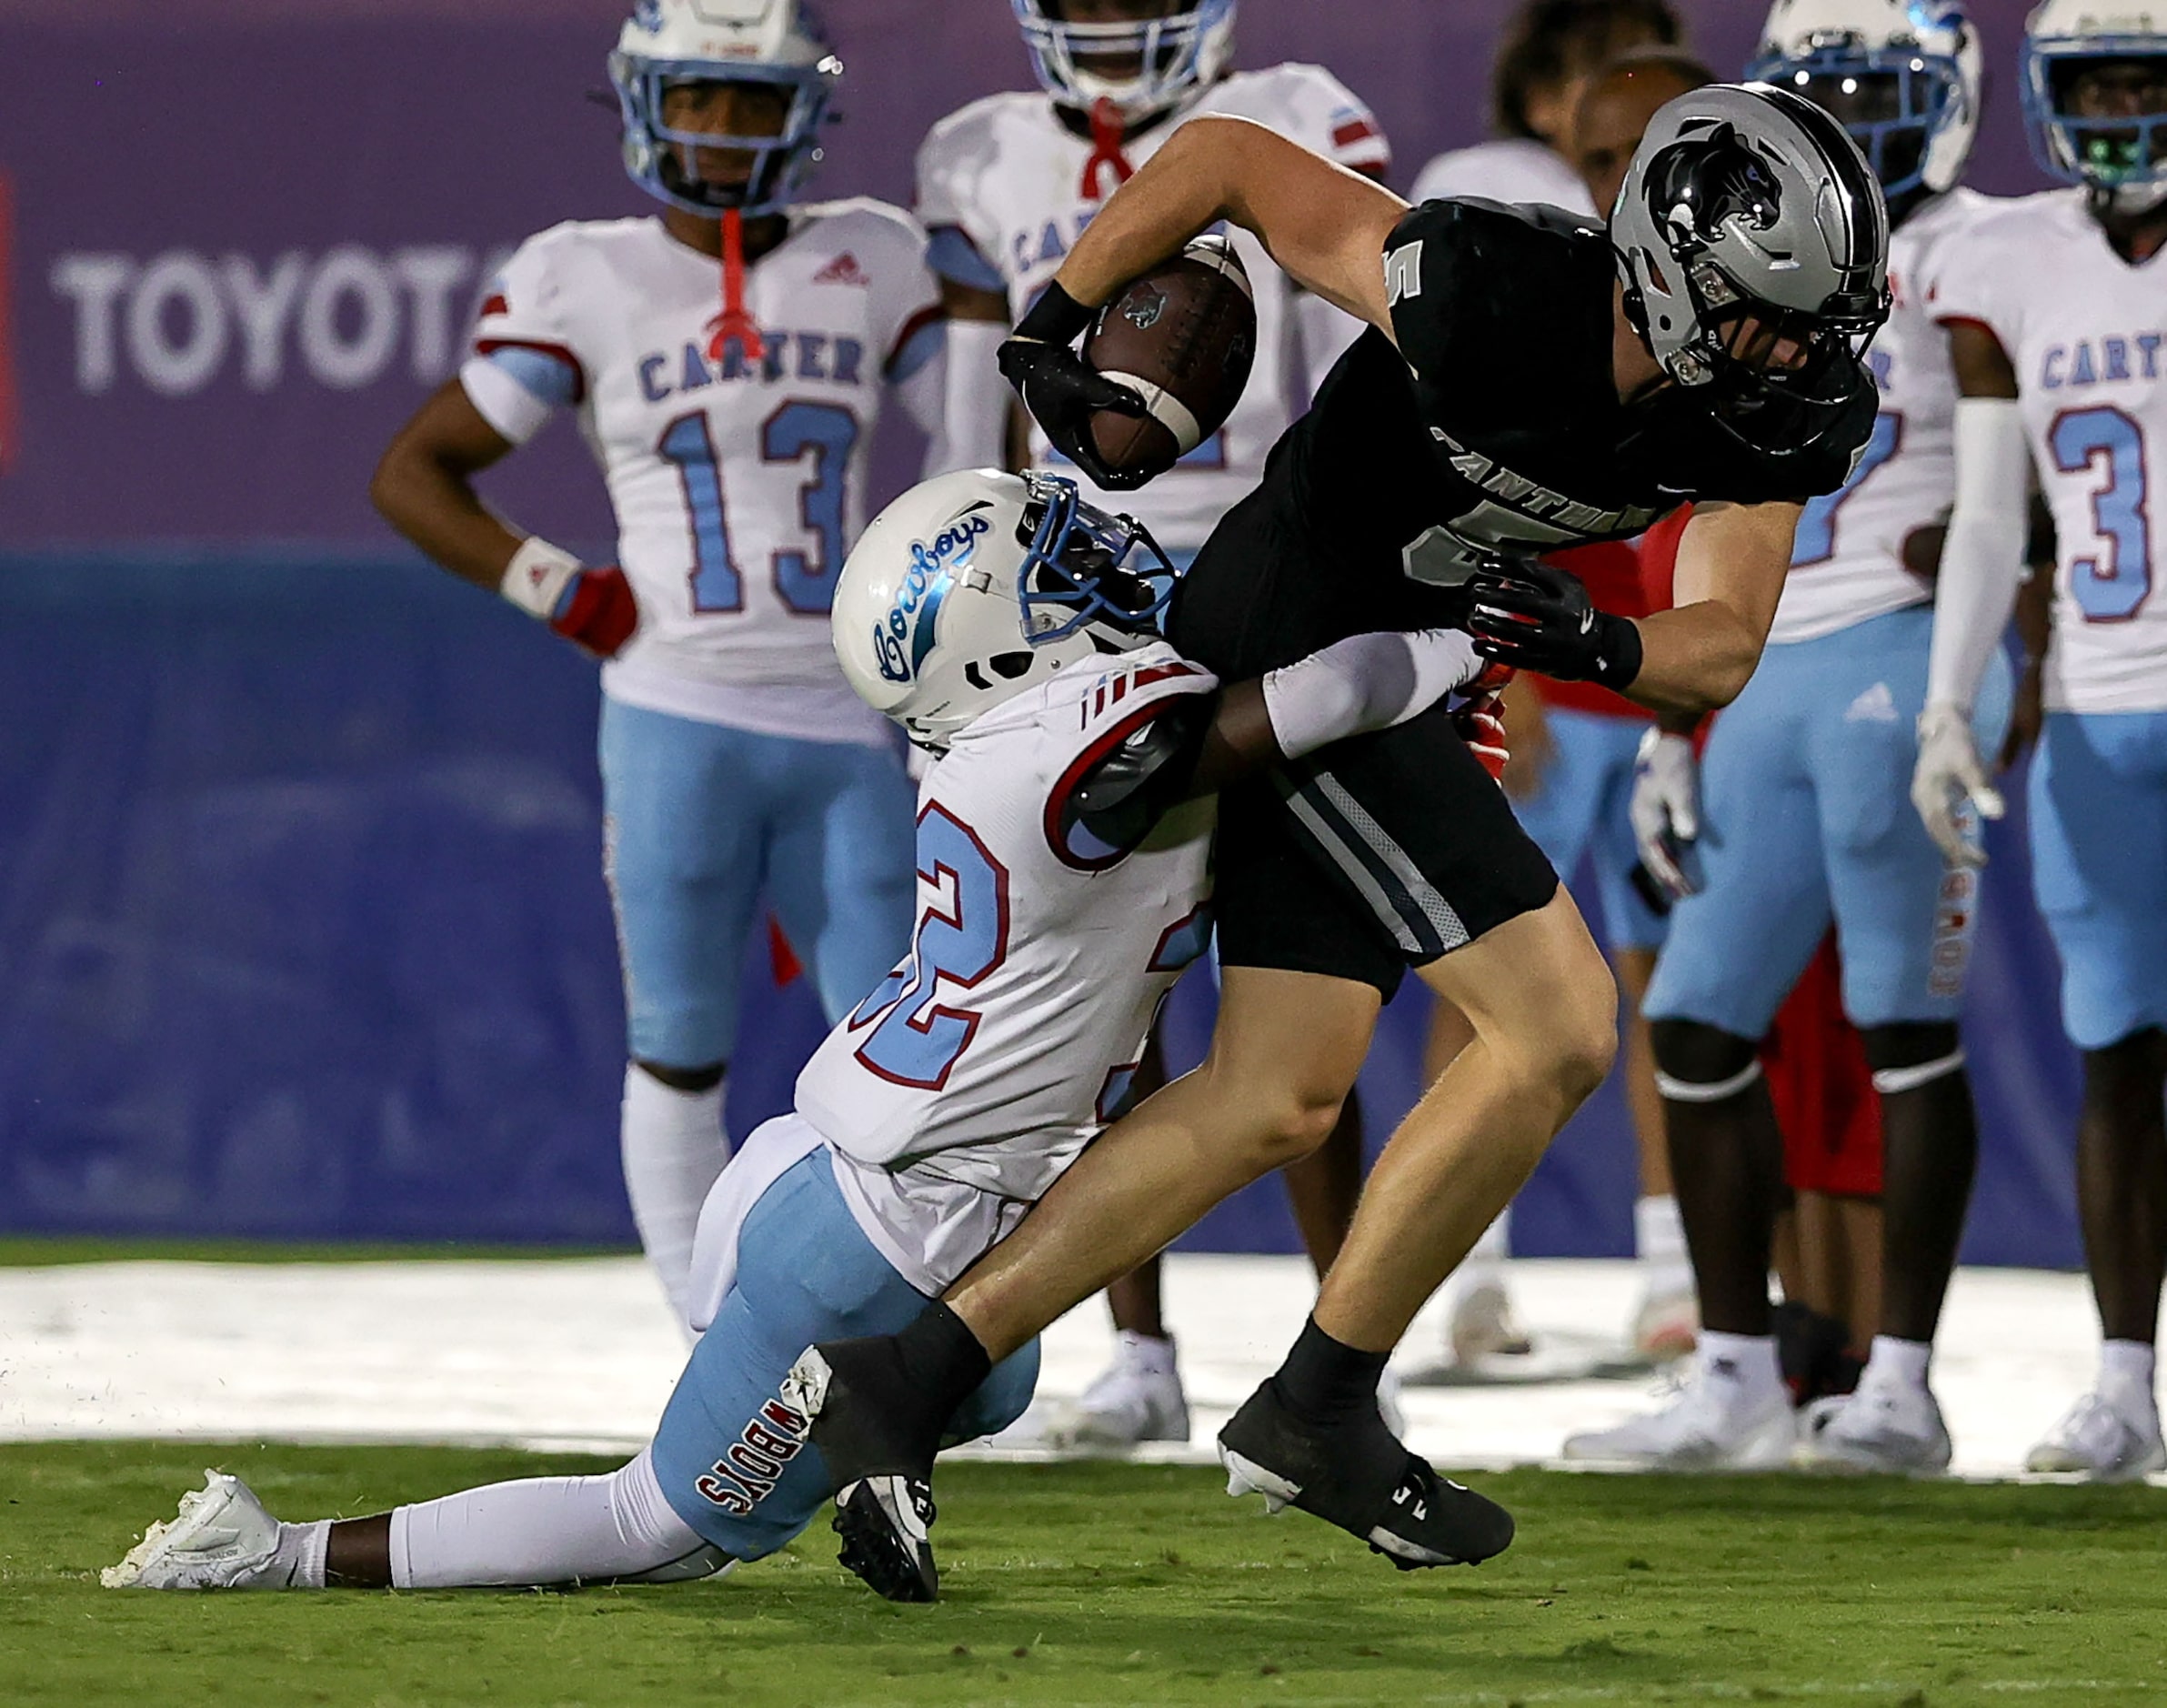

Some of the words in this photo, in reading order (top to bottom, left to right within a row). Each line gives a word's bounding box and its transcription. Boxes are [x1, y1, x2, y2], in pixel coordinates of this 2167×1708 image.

[49, 246, 515, 397] TOYOT
[2042, 335, 2167, 389] CART
[657, 398, 858, 617] 13
[872, 513, 992, 684] Cowboys
[2048, 405, 2152, 625] 3
[848, 799, 1009, 1091] 2
